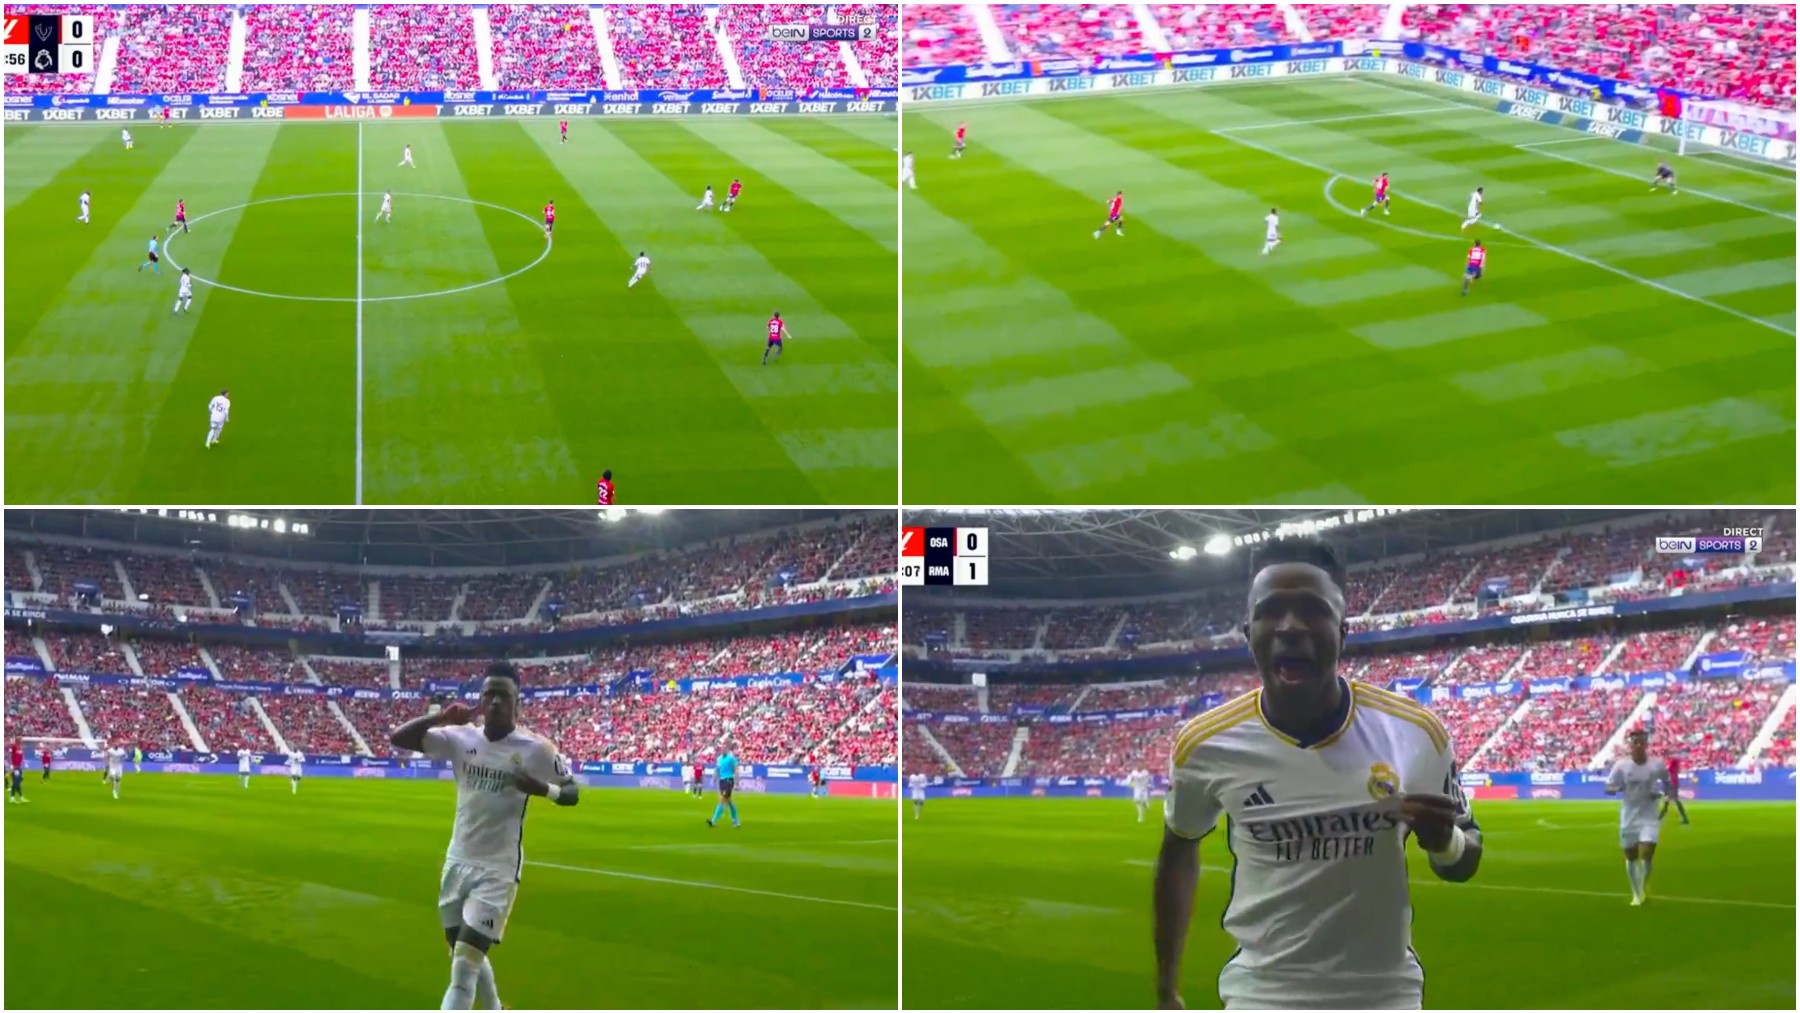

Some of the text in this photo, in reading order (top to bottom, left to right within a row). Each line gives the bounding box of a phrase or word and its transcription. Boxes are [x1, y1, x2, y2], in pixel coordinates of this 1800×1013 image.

[251, 107, 284, 117] 1XBE
[325, 105, 376, 119] LALIGA
[454, 104, 494, 115] 1XBET
[504, 103, 543, 115] 1XBET
[554, 103, 592, 114] 1XBET
[602, 103, 642, 114] 1XBET
[652, 103, 691, 113] 1XBET
[701, 102, 740, 113] 1XBET
[750, 102, 789, 113] 1XBET
[799, 101, 838, 113] 1XBET
[847, 101, 885, 112] 1XBET
[4, 109, 31, 120] BET
[42, 109, 84, 120] 1XBET
[95, 108, 137, 120] 1XBET
[148, 107, 188, 118] 1ET
[199, 107, 240, 118] 1XBET
[463, 761, 513, 781] Emirate
[1249, 808, 1398, 842] Emirates
[1311, 836, 1375, 861] BETTER
